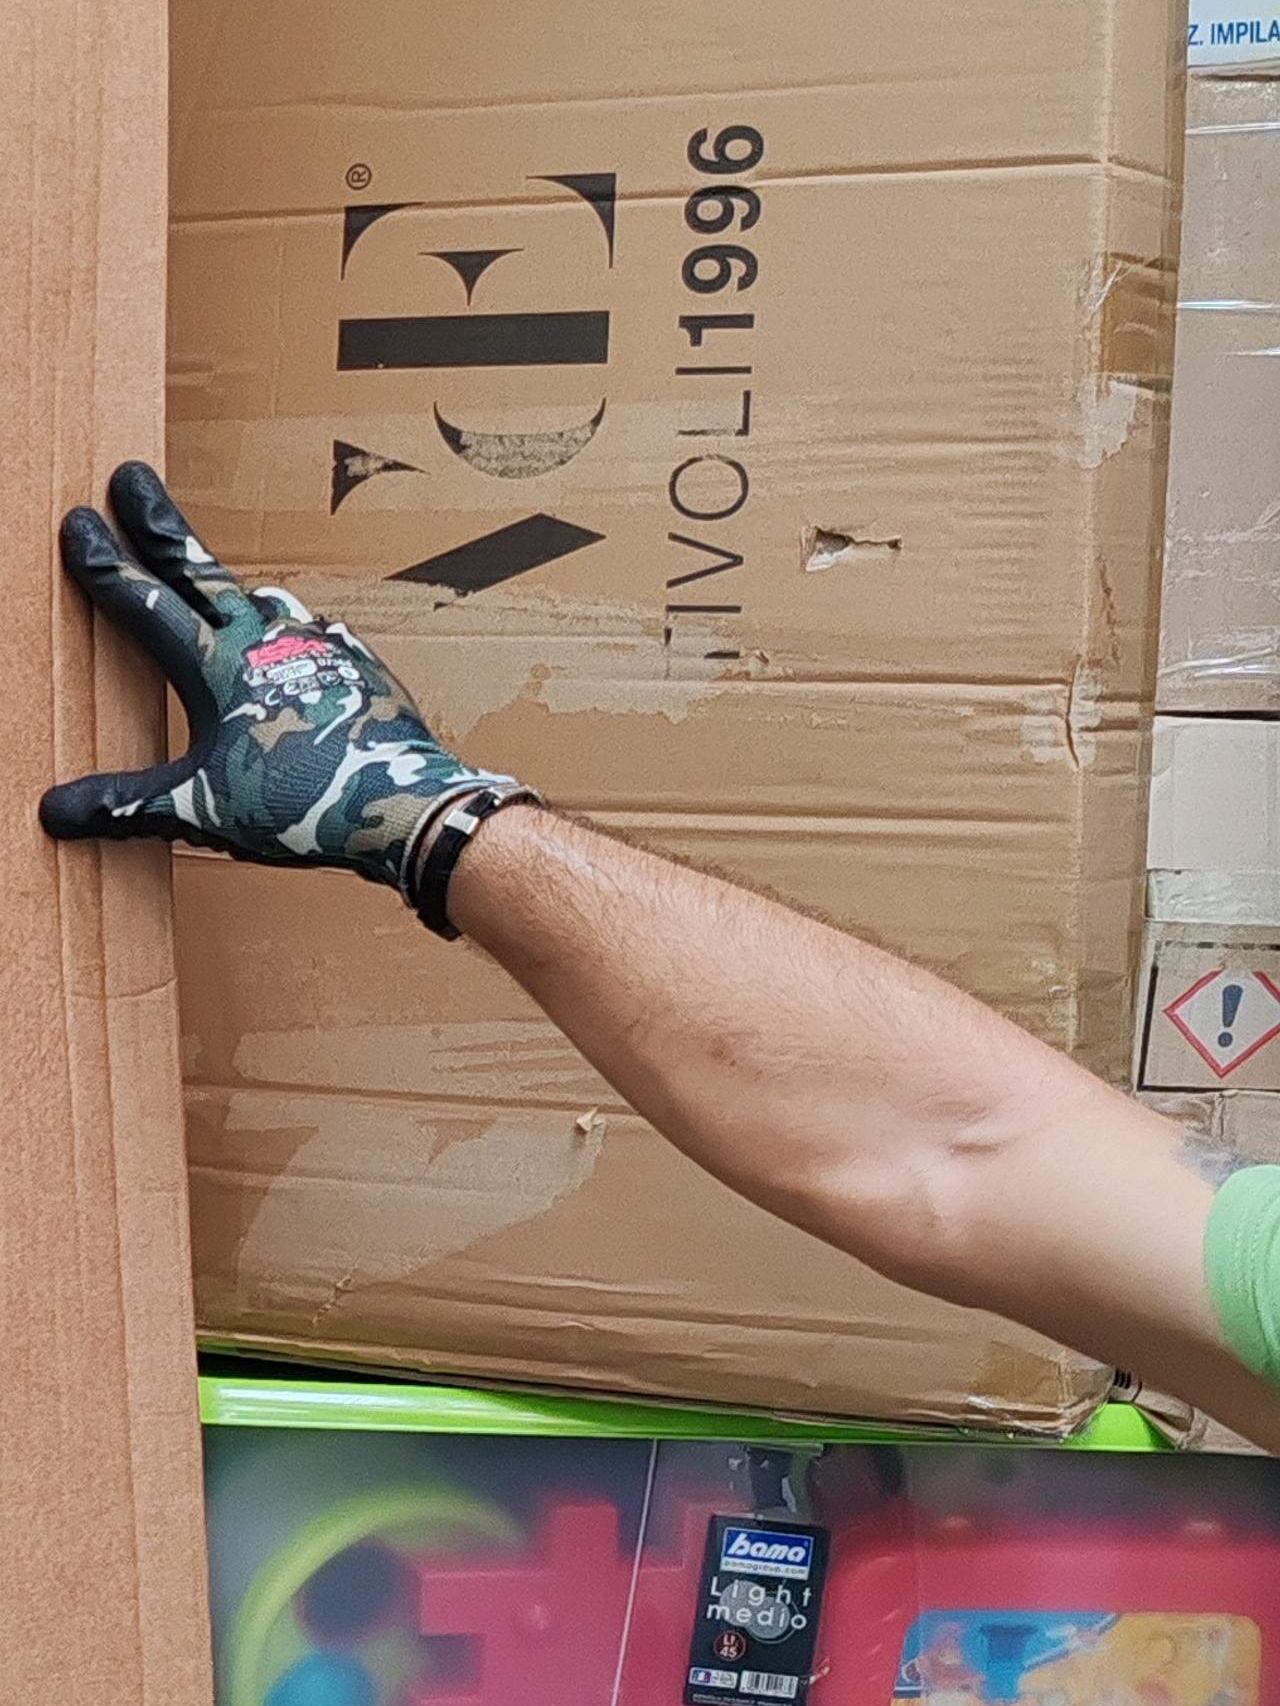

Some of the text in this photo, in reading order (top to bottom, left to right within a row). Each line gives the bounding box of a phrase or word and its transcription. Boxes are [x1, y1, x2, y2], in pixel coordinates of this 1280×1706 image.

[726, 1533, 807, 1563] bama
[710, 1576, 812, 1607] Light
[706, 1603, 807, 1630] medio
[720, 1646, 738, 1659] 45
